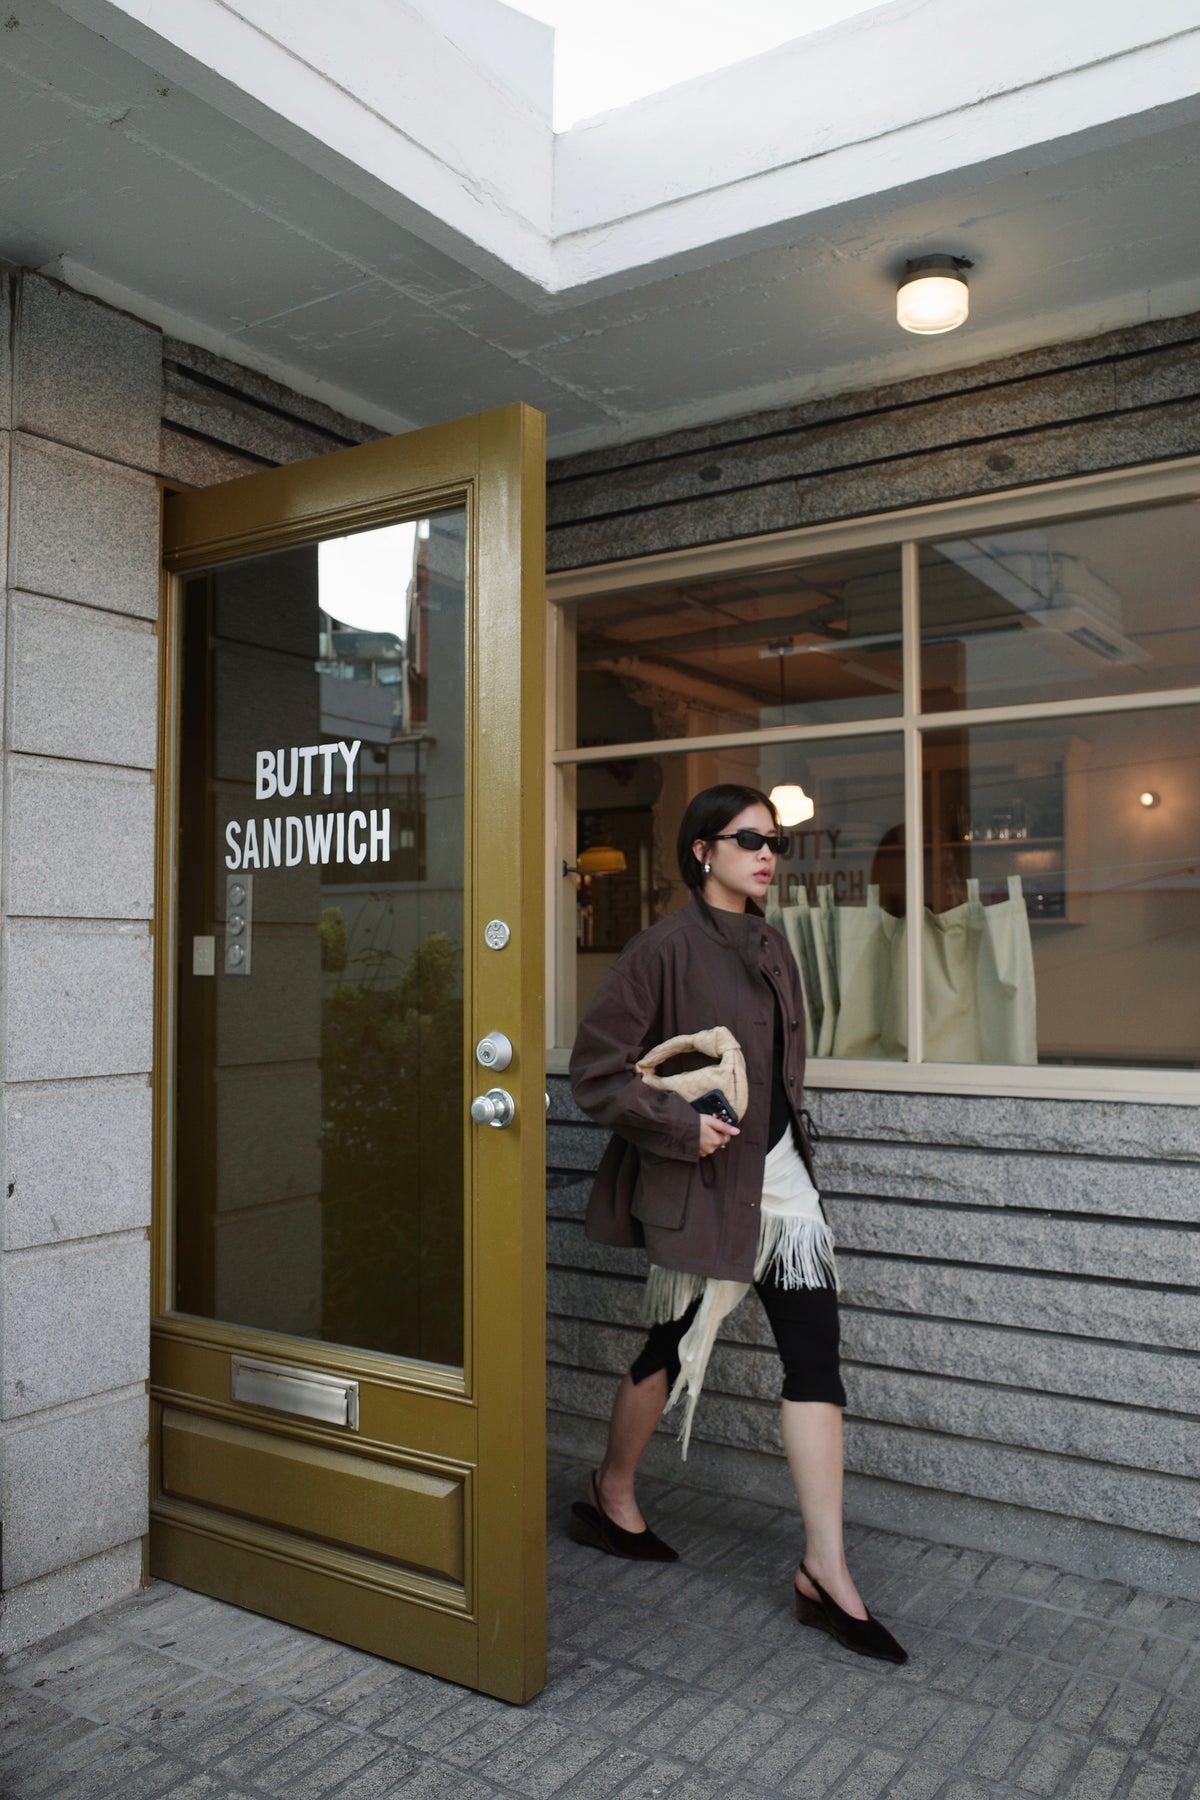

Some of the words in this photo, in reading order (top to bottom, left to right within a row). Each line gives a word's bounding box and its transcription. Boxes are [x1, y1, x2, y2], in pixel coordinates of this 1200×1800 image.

[256, 740, 361, 800] BUTTY
[225, 808, 391, 870] SANDWICH
[780, 829, 842, 861] UTTY
